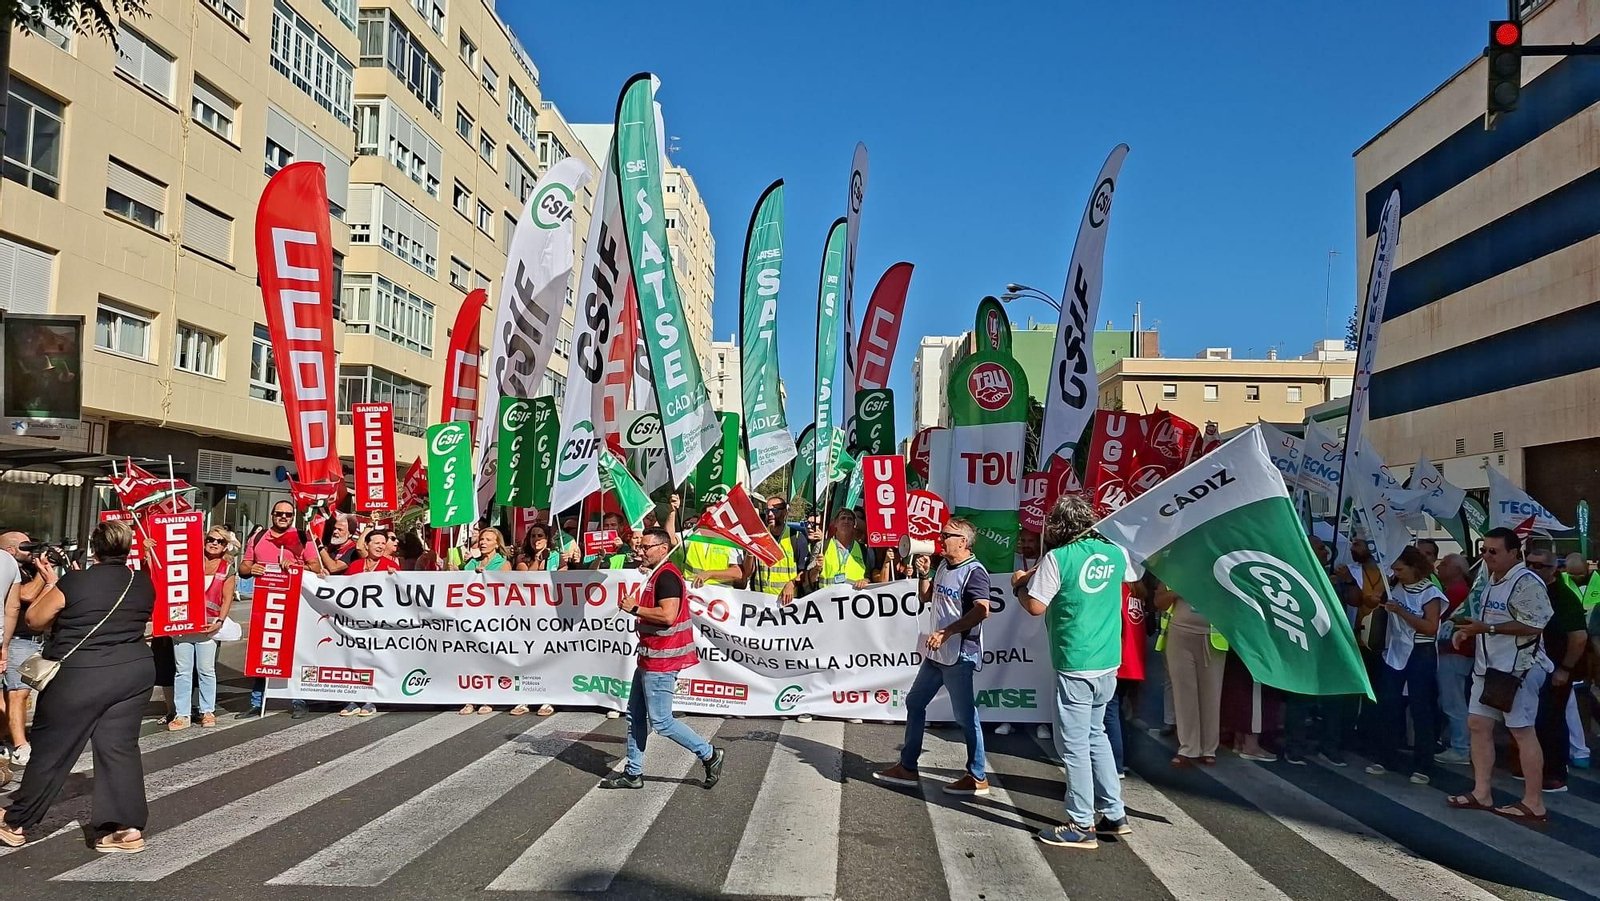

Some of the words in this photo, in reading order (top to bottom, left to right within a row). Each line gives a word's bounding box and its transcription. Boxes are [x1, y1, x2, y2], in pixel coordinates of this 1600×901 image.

[636, 188, 687, 389] SATSE
[578, 220, 619, 384] CSIF
[271, 227, 329, 462] CCOO
[1061, 263, 1088, 410] CSIF
[508, 411, 532, 422] CSIF
[535, 409, 551, 421] SIF
[865, 400, 890, 412] CSIF
[364, 412, 385, 484] CCOO
[437, 433, 465, 445] CSIF
[562, 438, 601, 460] CSIF
[870, 423, 882, 454] CS
[508, 436, 523, 502] CSIF
[536, 435, 551, 502] CSI
[1302, 454, 1340, 482] TECNO
[443, 457, 458, 522] CSIF
[873, 460, 897, 530] UGT
[1022, 477, 1048, 499] UG
[1159, 468, 1236, 517] CÁDIZ
[365, 500, 389, 508] CÁDIZ
[154, 515, 197, 524] SANIDAD
[165, 523, 189, 604] CCOO
[1087, 563, 1115, 581] CSIF
[315, 584, 384, 608] POR
[395, 584, 435, 608] UN
[446, 582, 607, 608] ESTATUTO
[740, 600, 823, 627] PARA
[1249, 550, 1309, 651] CSIF
[164, 622, 194, 631] CÁDIZ
[262, 591, 287, 650] COO
[333, 613, 393, 629] NUEVA
[397, 615, 531, 632] CLASIFICACIÓN
[537, 617, 573, 633] CON
[700, 623, 814, 651] RETRIBUTIVA
[336, 634, 438, 652] JUBILACIÓN
[442, 640, 518, 654] PARCIAL
[524, 640, 535, 654] Y
[696, 646, 780, 670] MEJORAS
[785, 658, 809, 670] EN
[816, 656, 840, 670] LA
[845, 652, 922, 670] JORNAD
[982, 647, 1033, 665] ORAL
[256, 667, 283, 675] CÁDIZ
[322, 670, 360, 682] CCOO
[408, 676, 431, 687] CSIF
[458, 675, 494, 689] UGT
[572, 674, 631, 699] SATSE
[694, 683, 735, 696] CCOO
[832, 690, 870, 704] UGT
[974, 688, 1037, 708] ATSE
